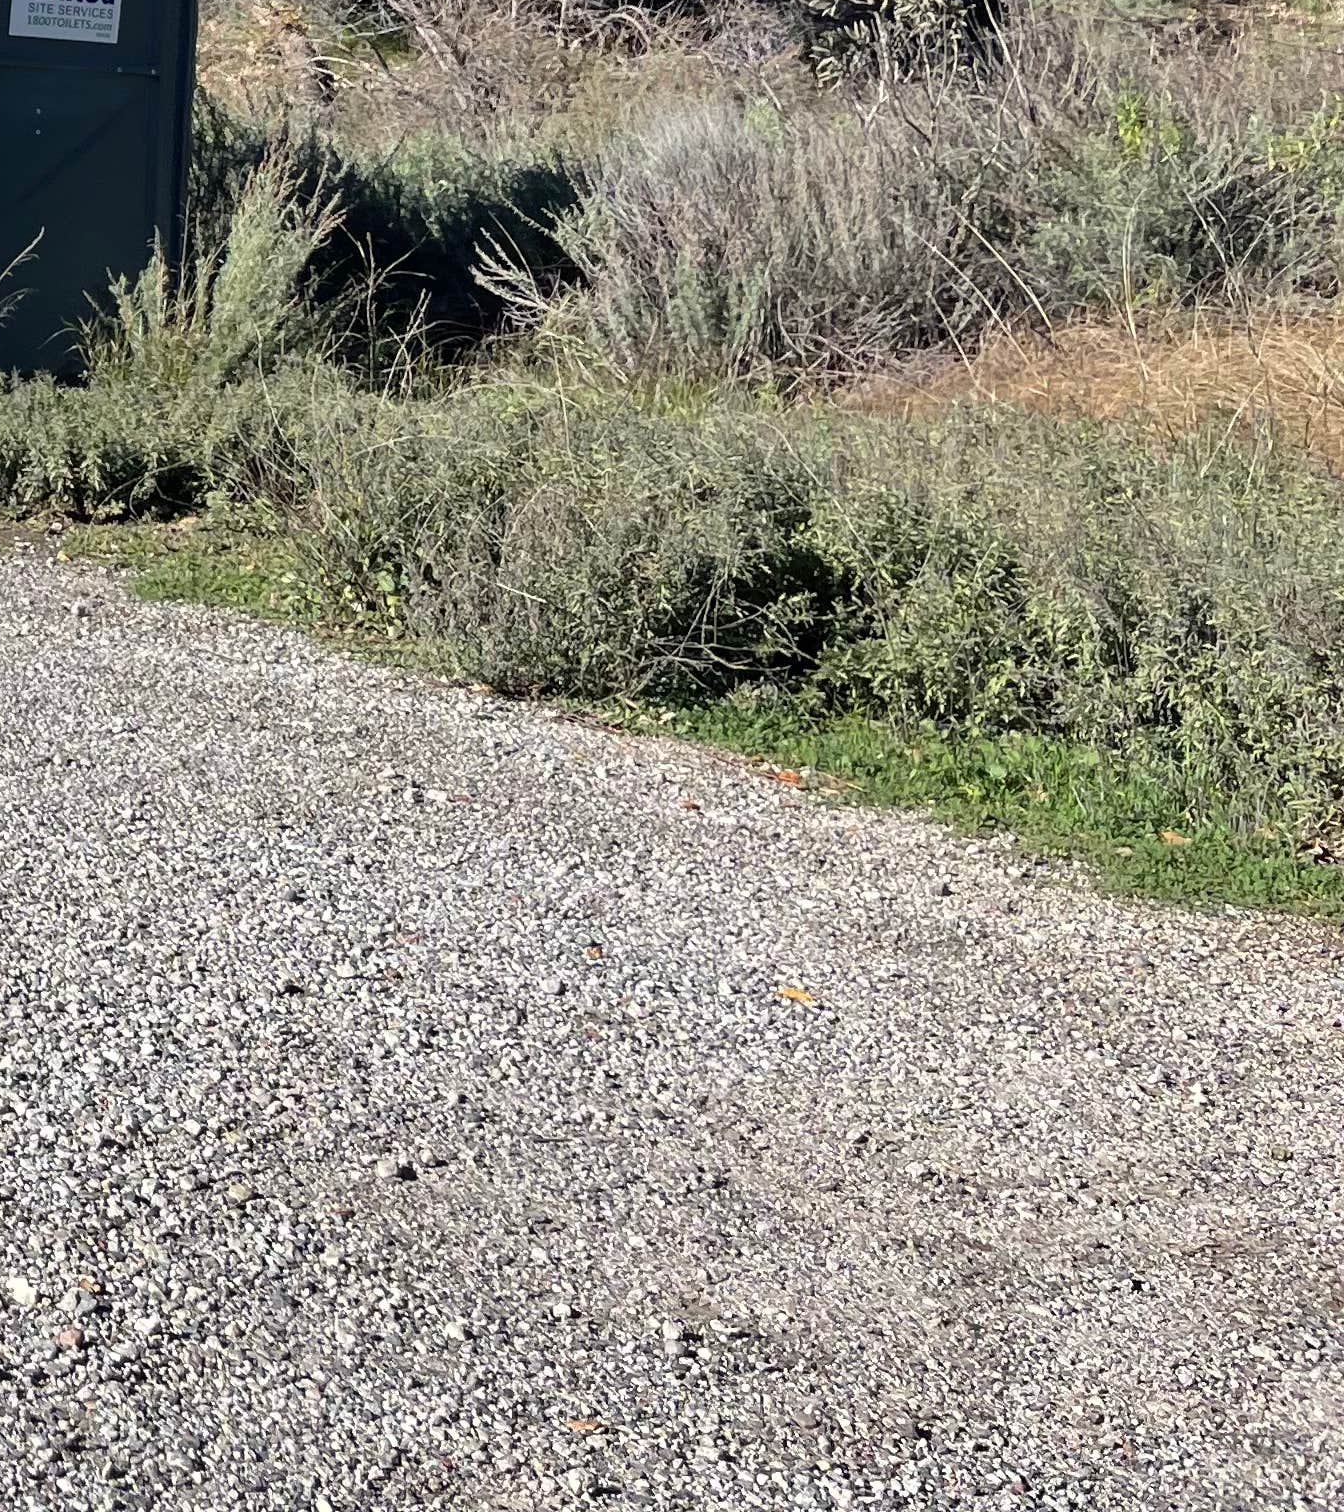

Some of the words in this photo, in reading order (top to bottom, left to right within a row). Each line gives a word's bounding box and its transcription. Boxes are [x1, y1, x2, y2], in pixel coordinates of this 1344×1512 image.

[27, 1, 54, 15] SITE
[57, 4, 114, 20] SERVICES
[27, 14, 113, 32] 1800TOILETS.com
